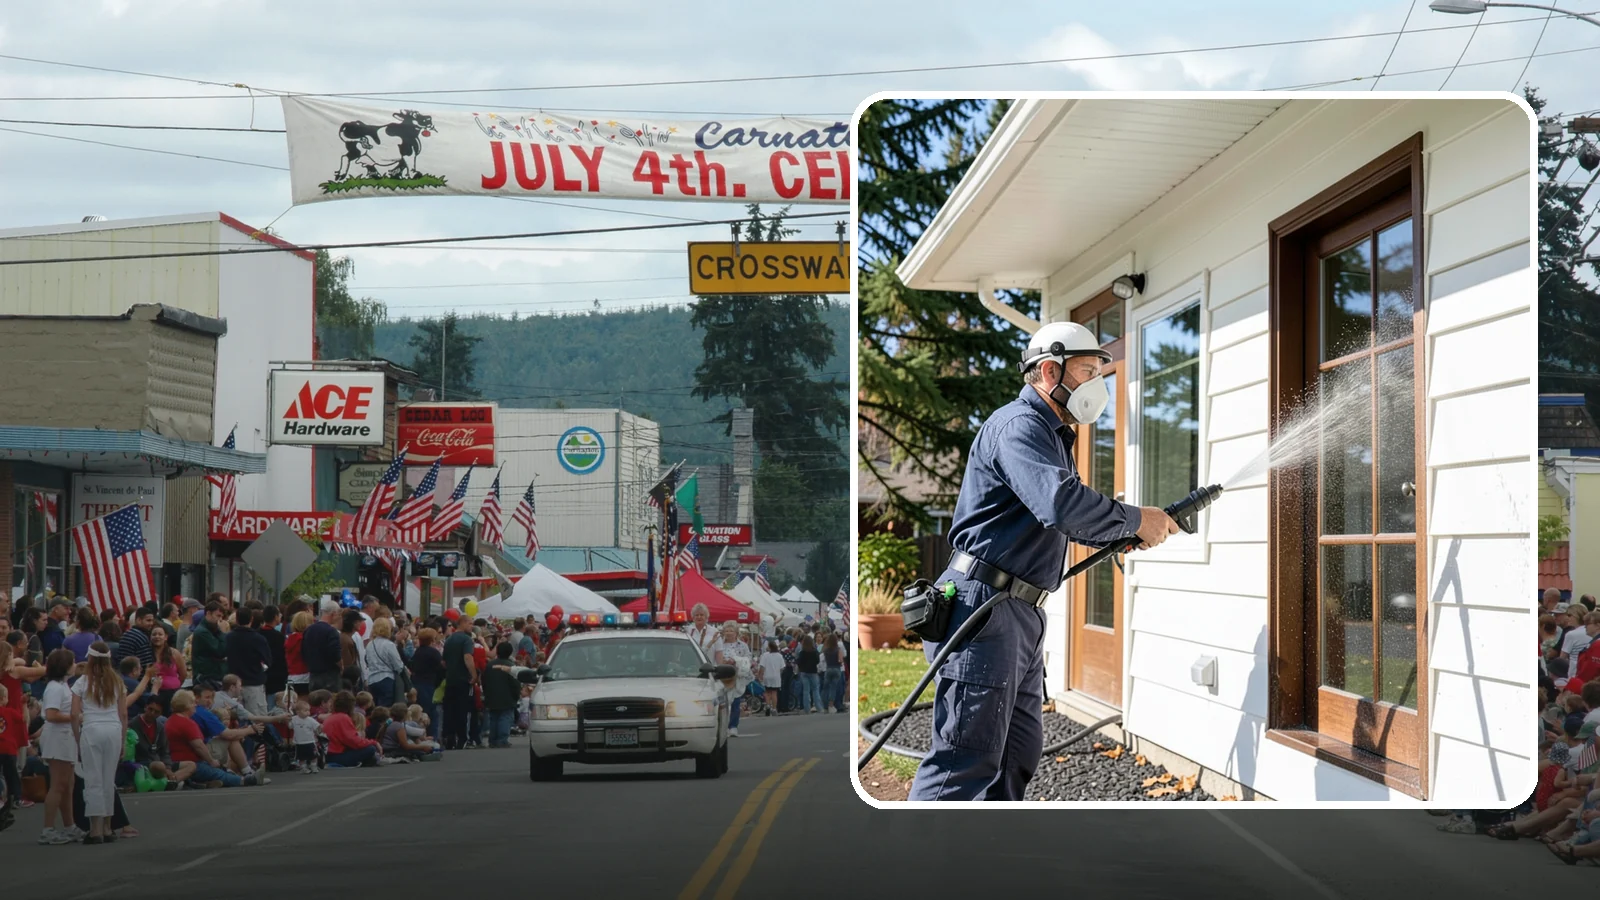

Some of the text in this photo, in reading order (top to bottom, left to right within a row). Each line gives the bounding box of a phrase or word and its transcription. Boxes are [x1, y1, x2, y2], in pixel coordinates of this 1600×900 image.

[695, 121, 850, 151] Carnat
[481, 141, 605, 192] JULY
[632, 148, 746, 198] 4th.
[697, 254, 850, 280] CROSSWA
[282, 380, 373, 420] ACE
[405, 409, 452, 421] CEDAR
[283, 421, 371, 437] Hardware
[416, 428, 477, 447] Coca-Cola
[83, 484, 155, 495] St. Vincent de Paul
[688, 526, 741, 535] CRNATION
[699, 535, 730, 543] GLASS
